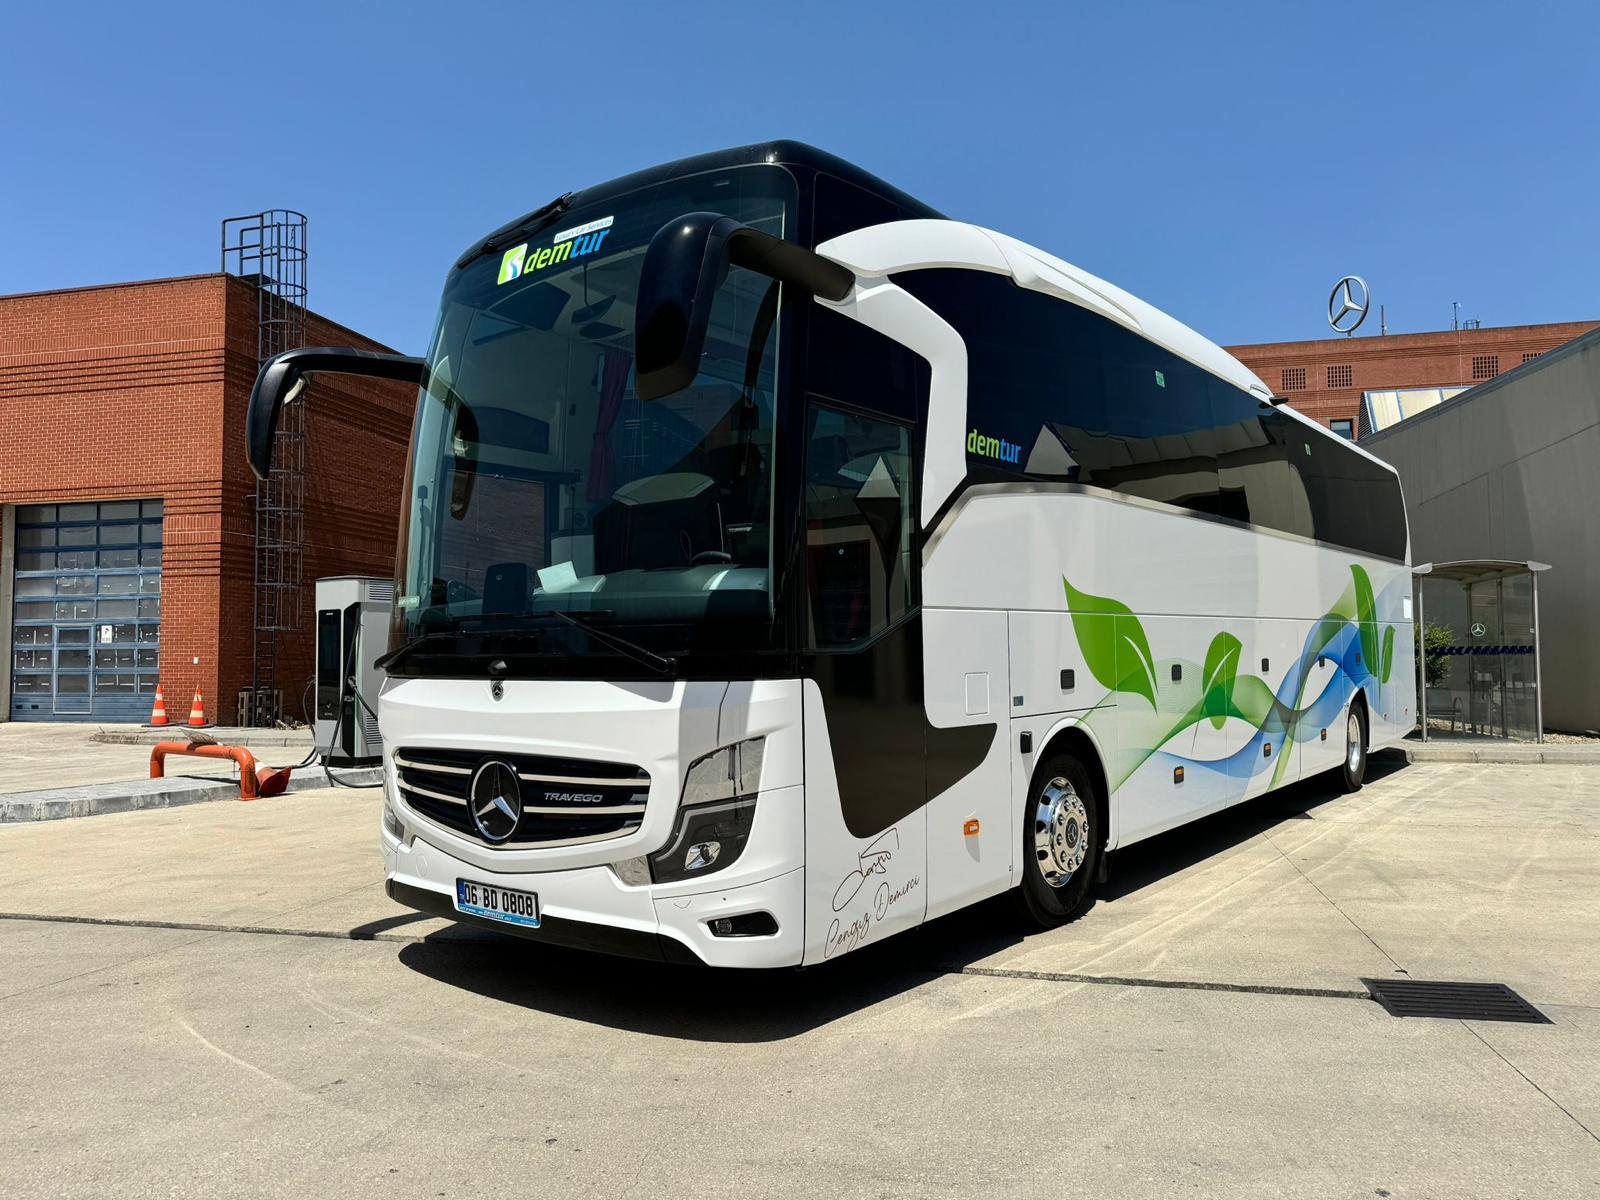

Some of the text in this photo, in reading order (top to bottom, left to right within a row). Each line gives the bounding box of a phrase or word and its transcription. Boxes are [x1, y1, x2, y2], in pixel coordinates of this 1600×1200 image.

[523, 229, 610, 274] demtur
[967, 428, 1021, 464] demtur
[543, 792, 603, 803] TRAVEGO
[464, 883, 533, 916] 06 BD 0808
